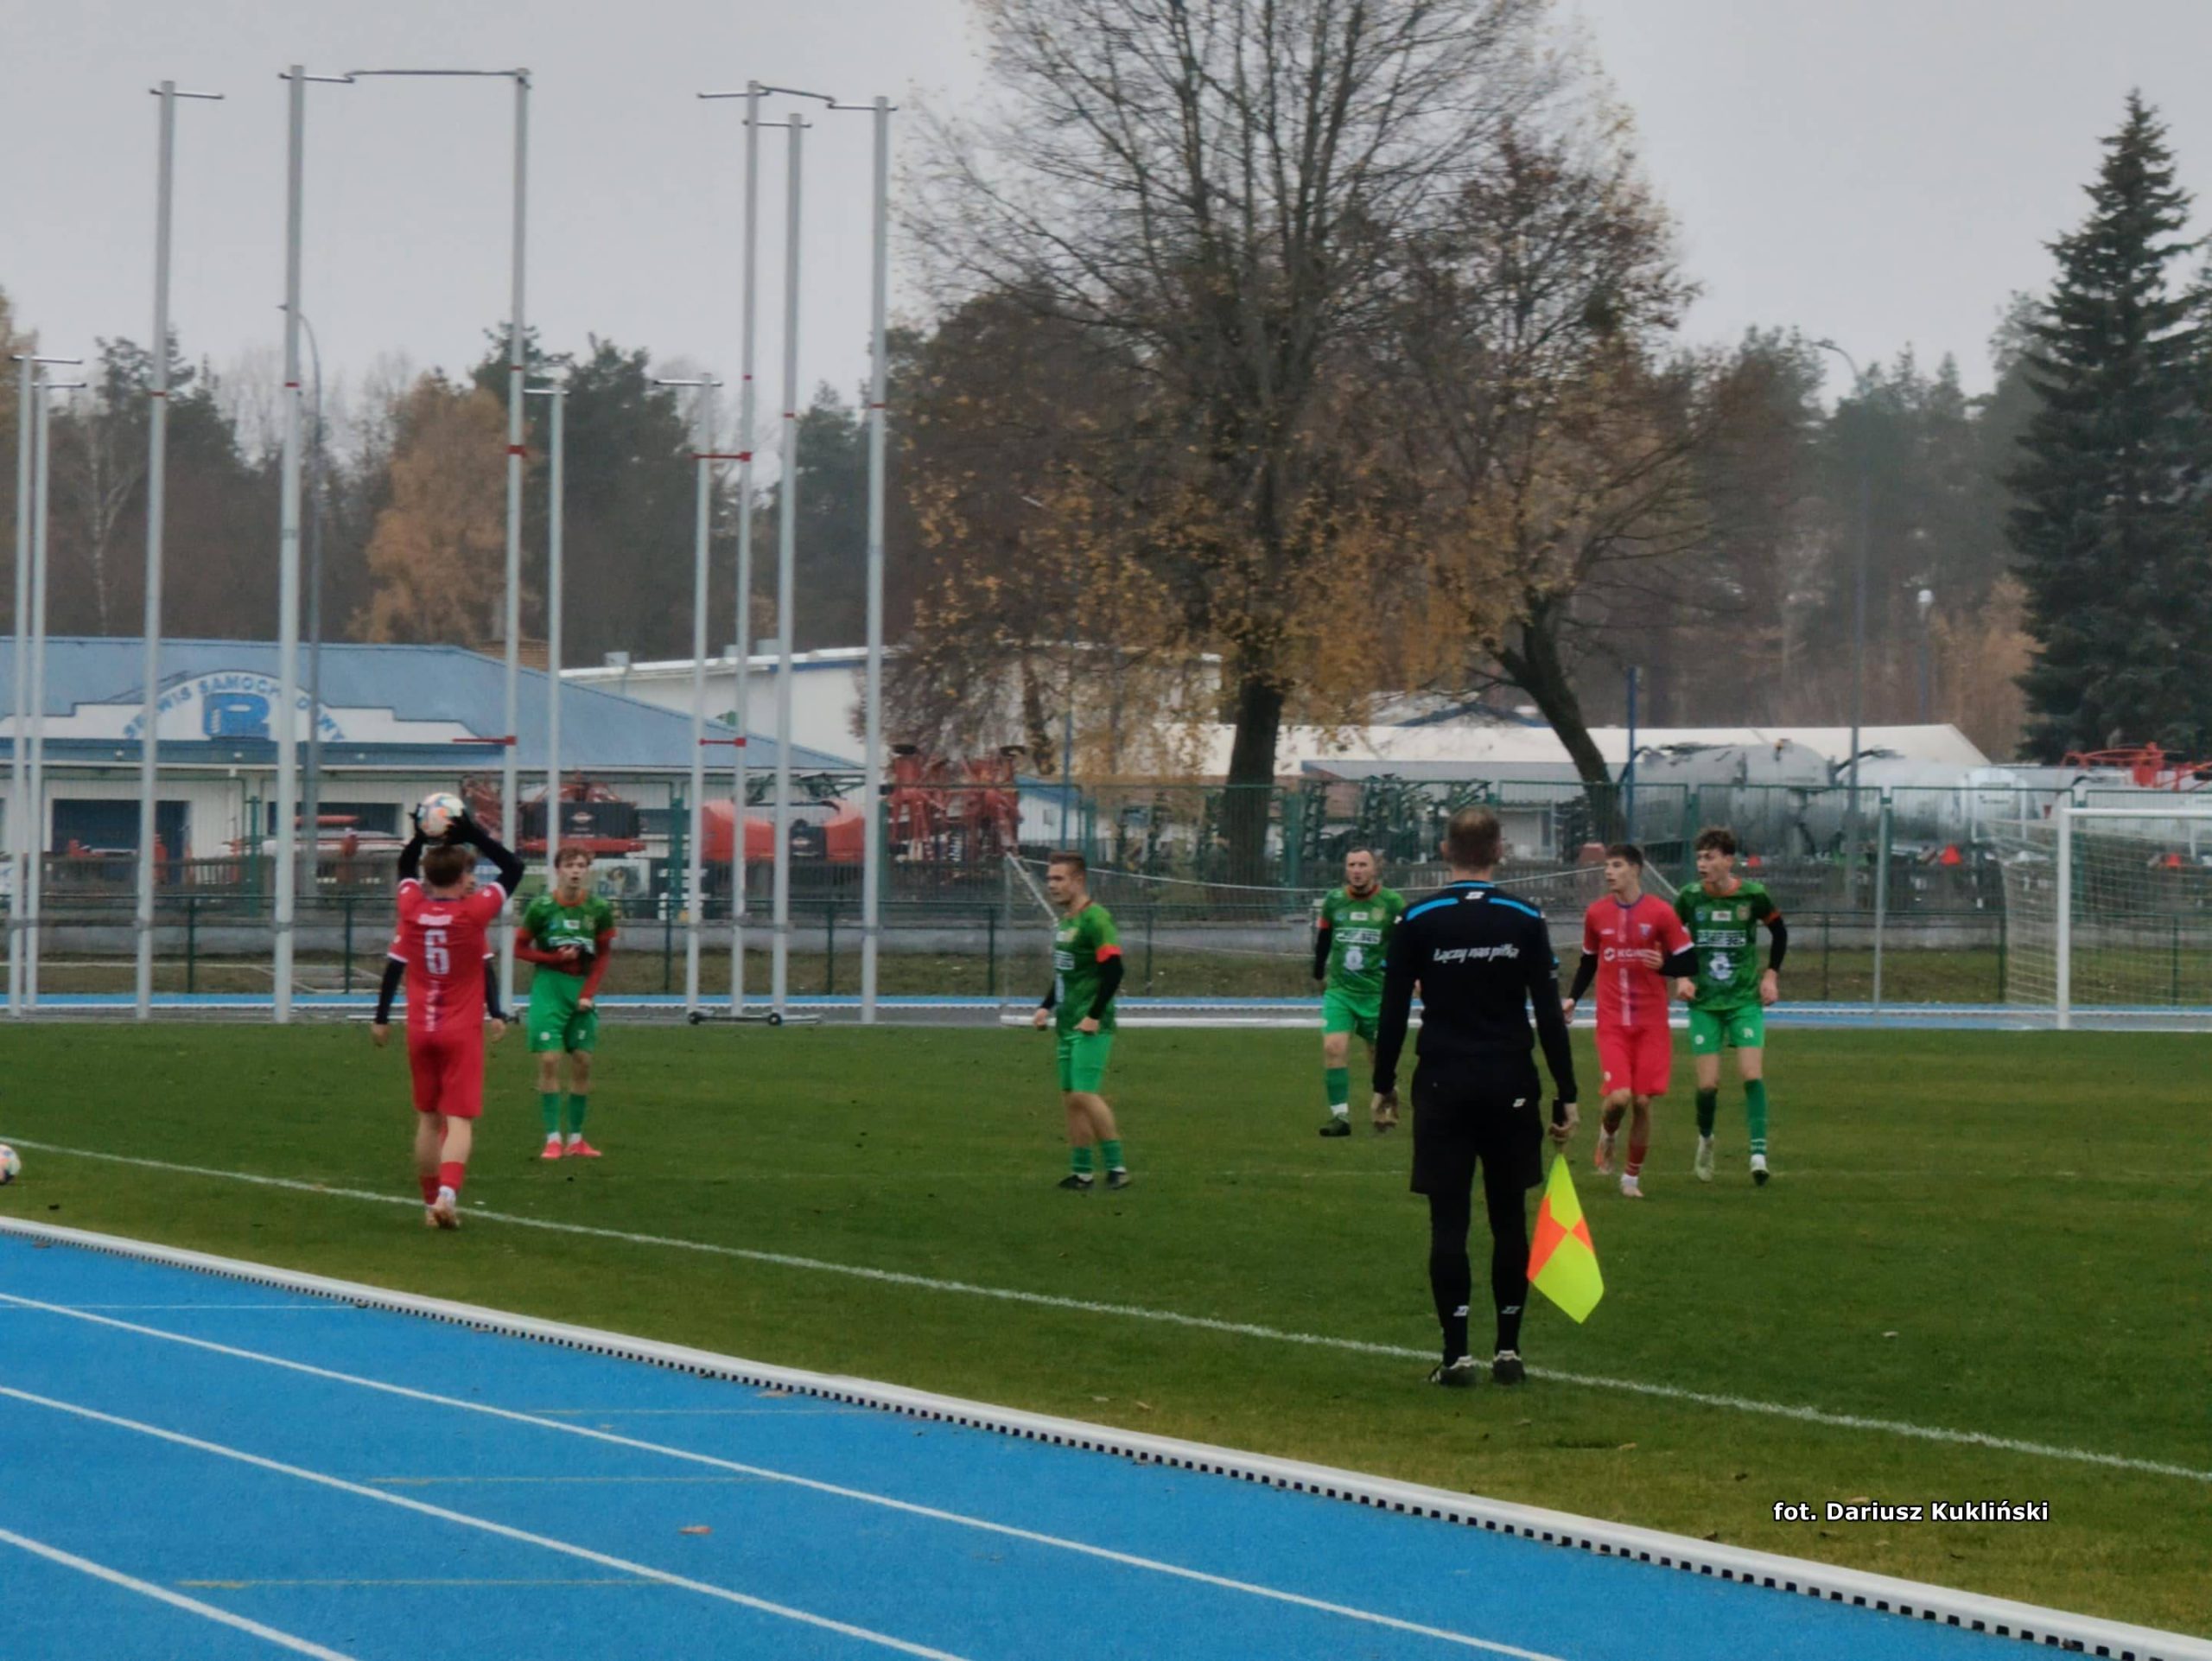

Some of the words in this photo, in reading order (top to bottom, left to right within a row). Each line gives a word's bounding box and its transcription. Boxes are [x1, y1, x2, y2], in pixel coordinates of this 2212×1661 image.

[123, 685, 192, 739] SEWIS
[423, 928, 450, 975] 6
[1468, 946, 1491, 958] nas
